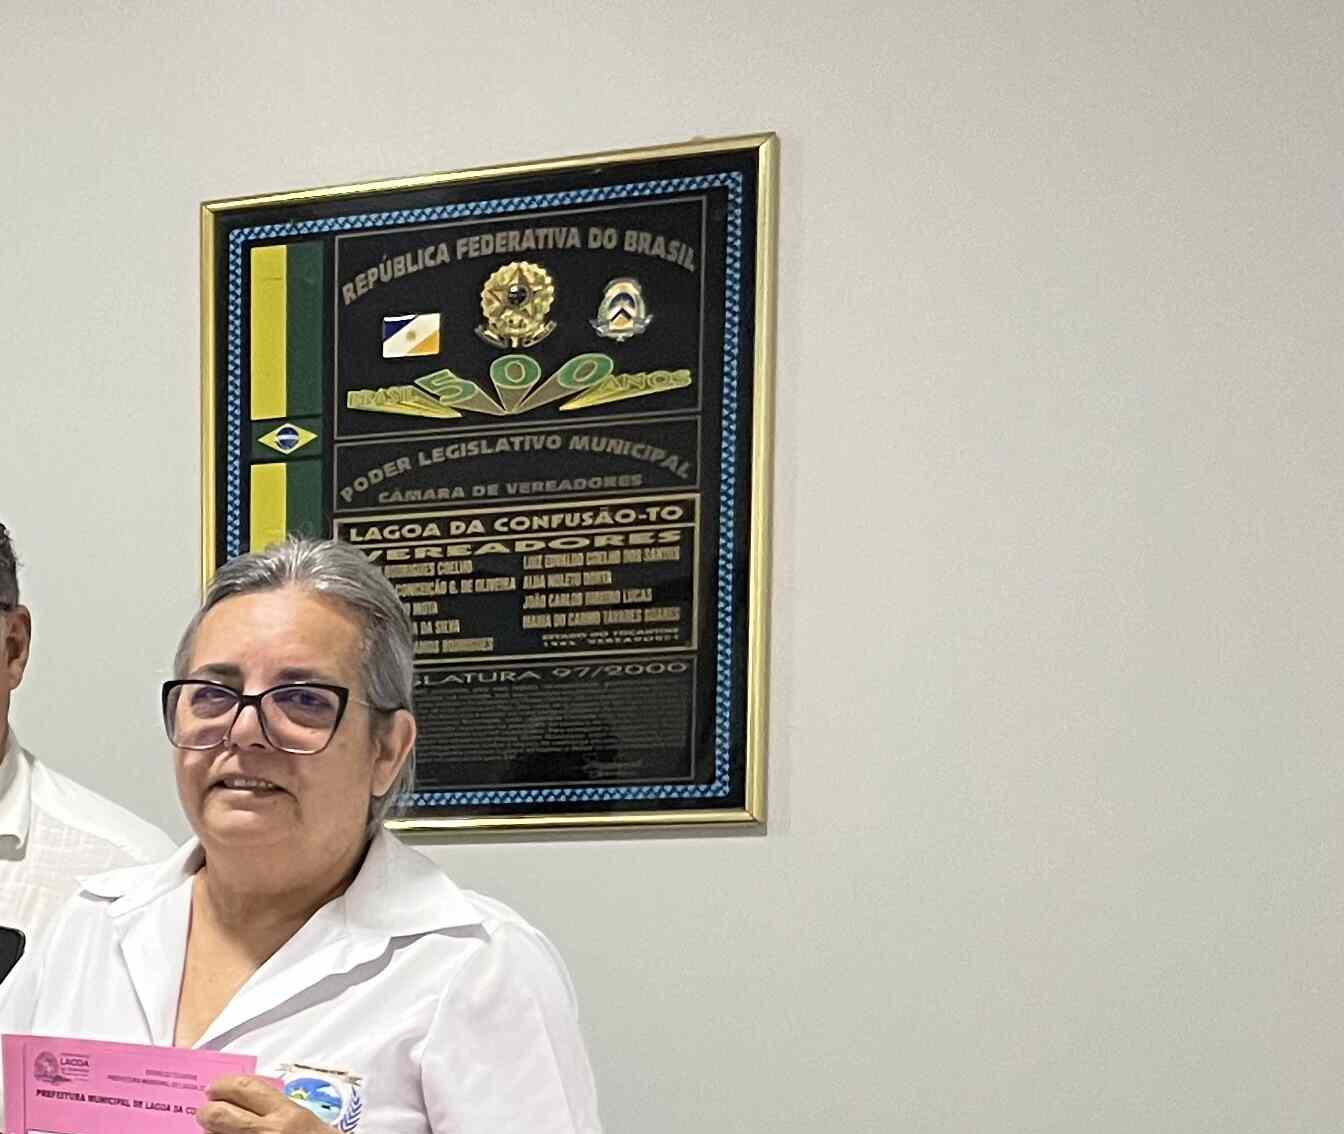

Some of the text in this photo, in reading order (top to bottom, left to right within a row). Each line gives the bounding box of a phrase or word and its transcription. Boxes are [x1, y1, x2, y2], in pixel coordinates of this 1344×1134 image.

[341, 226, 696, 305] REPÚBLICA FEDERATIVA DO BRASIL
[601, 369, 692, 391] ANOS
[340, 435, 693, 503] PODER LEGISLATIVO MUNICIPAL
[472, 484, 499, 496] DE
[506, 473, 643, 495] VEREADORES
[350, 505, 684, 541] LAGOA DA CONFUSÃO-TO
[552, 661, 688, 679] 97/2000
